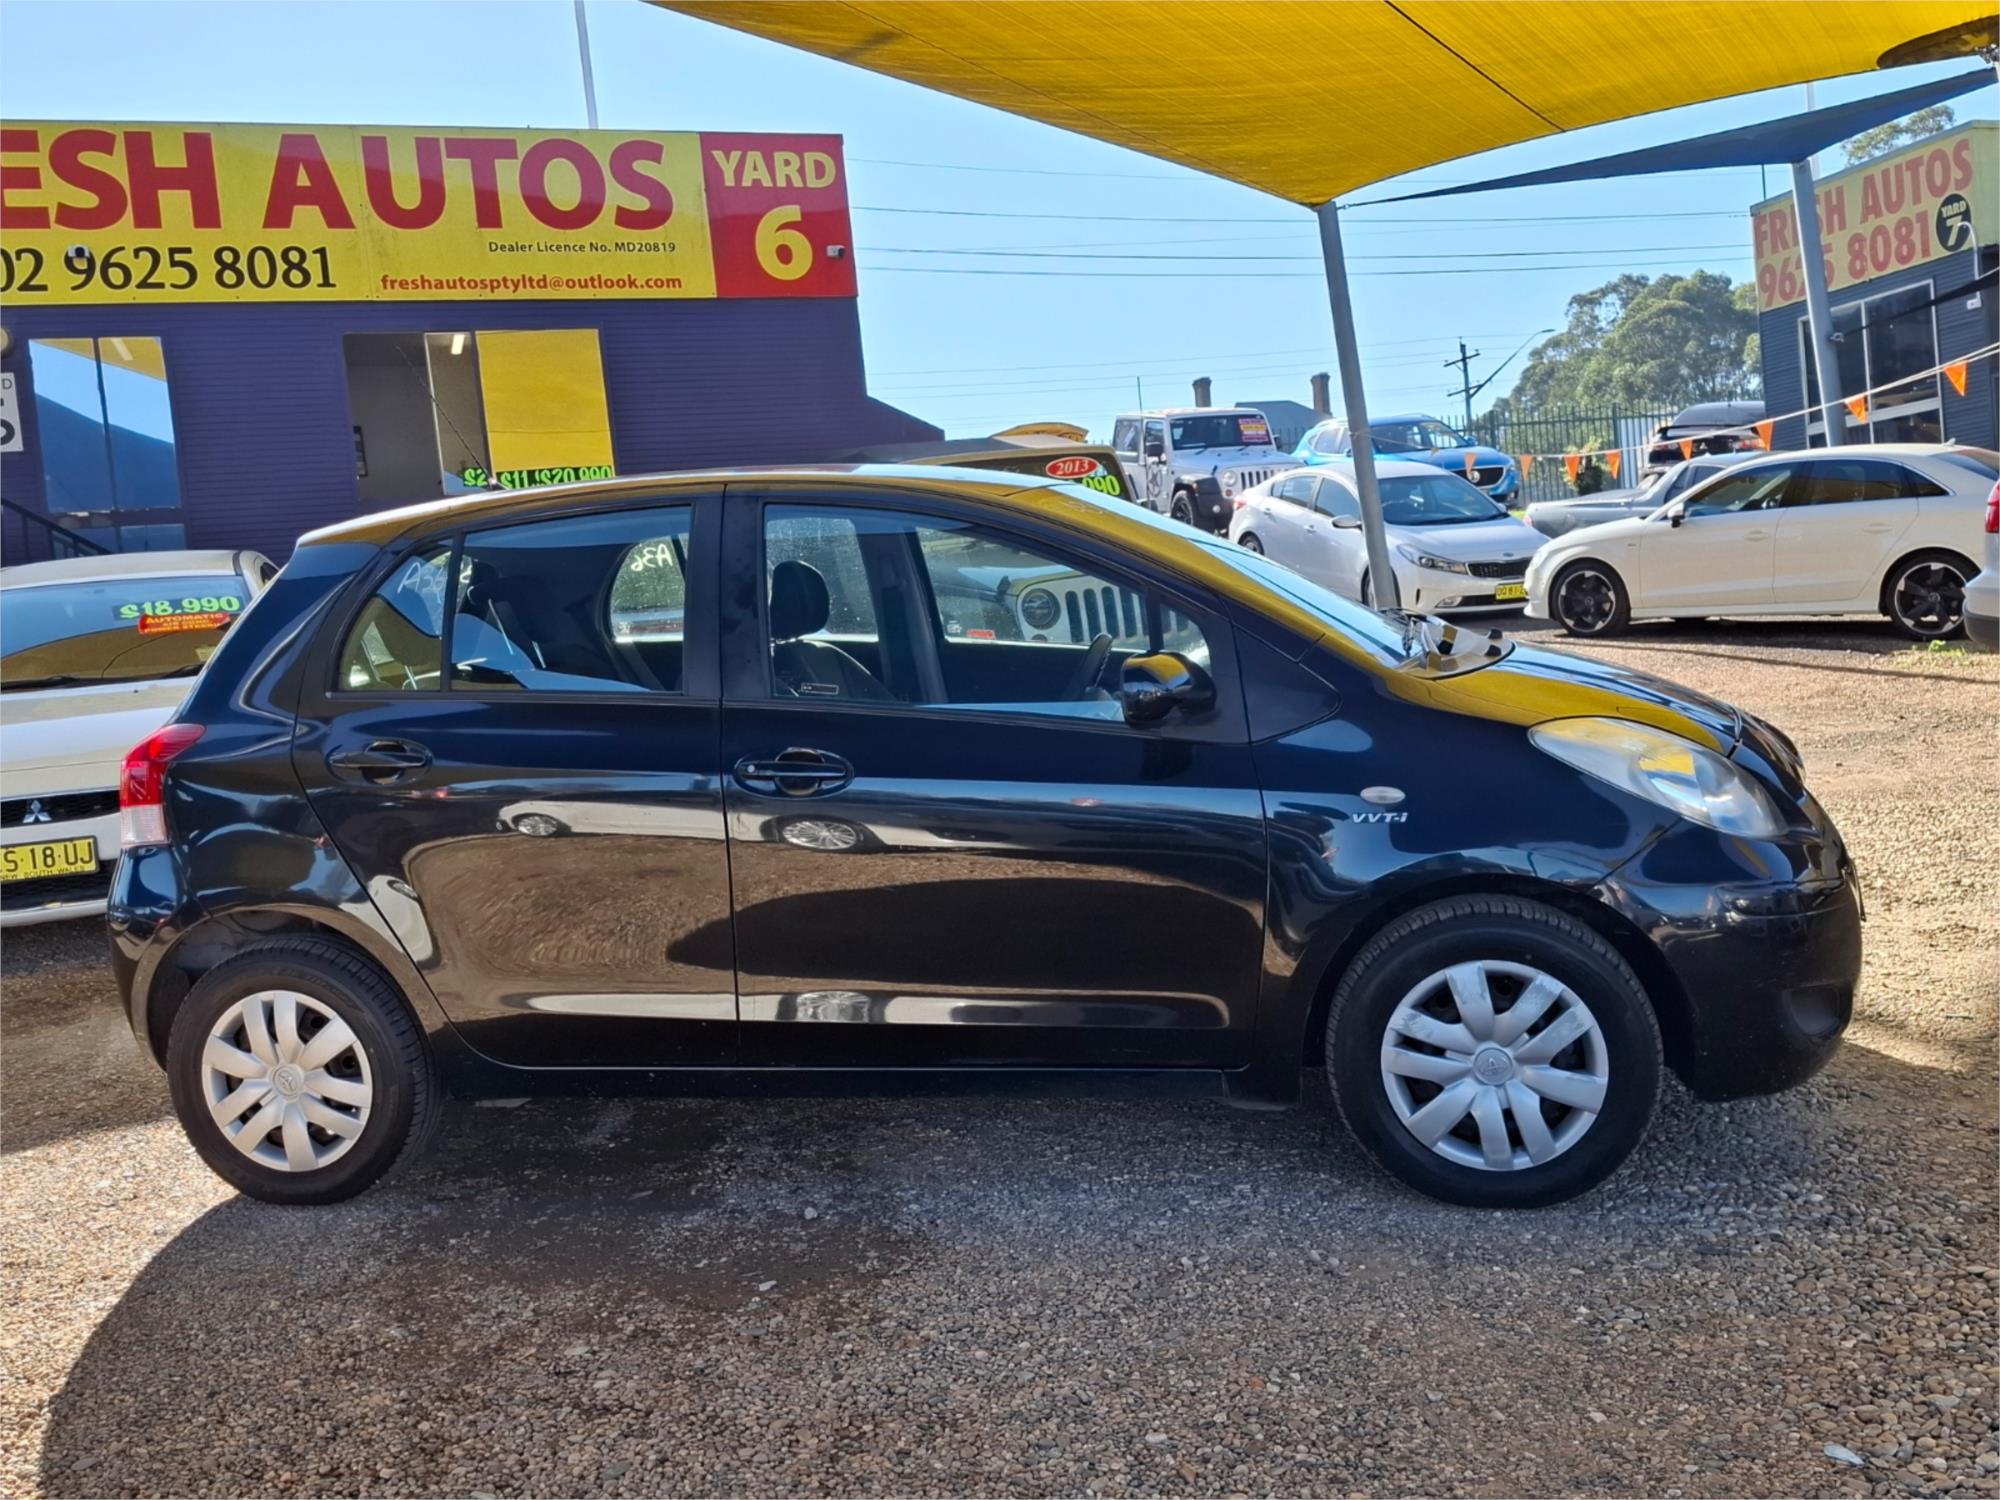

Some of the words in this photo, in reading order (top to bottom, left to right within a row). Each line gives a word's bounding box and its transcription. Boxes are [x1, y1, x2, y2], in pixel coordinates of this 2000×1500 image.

[262, 134, 674, 231] AUTOS
[712, 150, 836, 189] YARD
[1753, 185, 1847, 260] FRH
[1860, 138, 1973, 224] AUTOS
[1941, 200, 1967, 218] YARD
[755, 205, 813, 281] 6
[1946, 215, 1963, 247] 7
[489, 241, 533, 253] Dealer
[537, 241, 586, 253] Licence
[590, 241, 611, 253] No.
[614, 241, 676, 253] MD20819
[1847, 210, 1932, 280] 8081
[63, 246, 199, 292] 9625
[213, 246, 337, 289] 8081
[381, 274, 682, 294] freshautosptyltd@outlook.com
[1056, 460, 1089, 475] 2013
[119, 596, 240, 618] $18.990
[145, 613, 224, 624] AUTOMATIC
[1353, 812, 1408, 823] VVT-i
